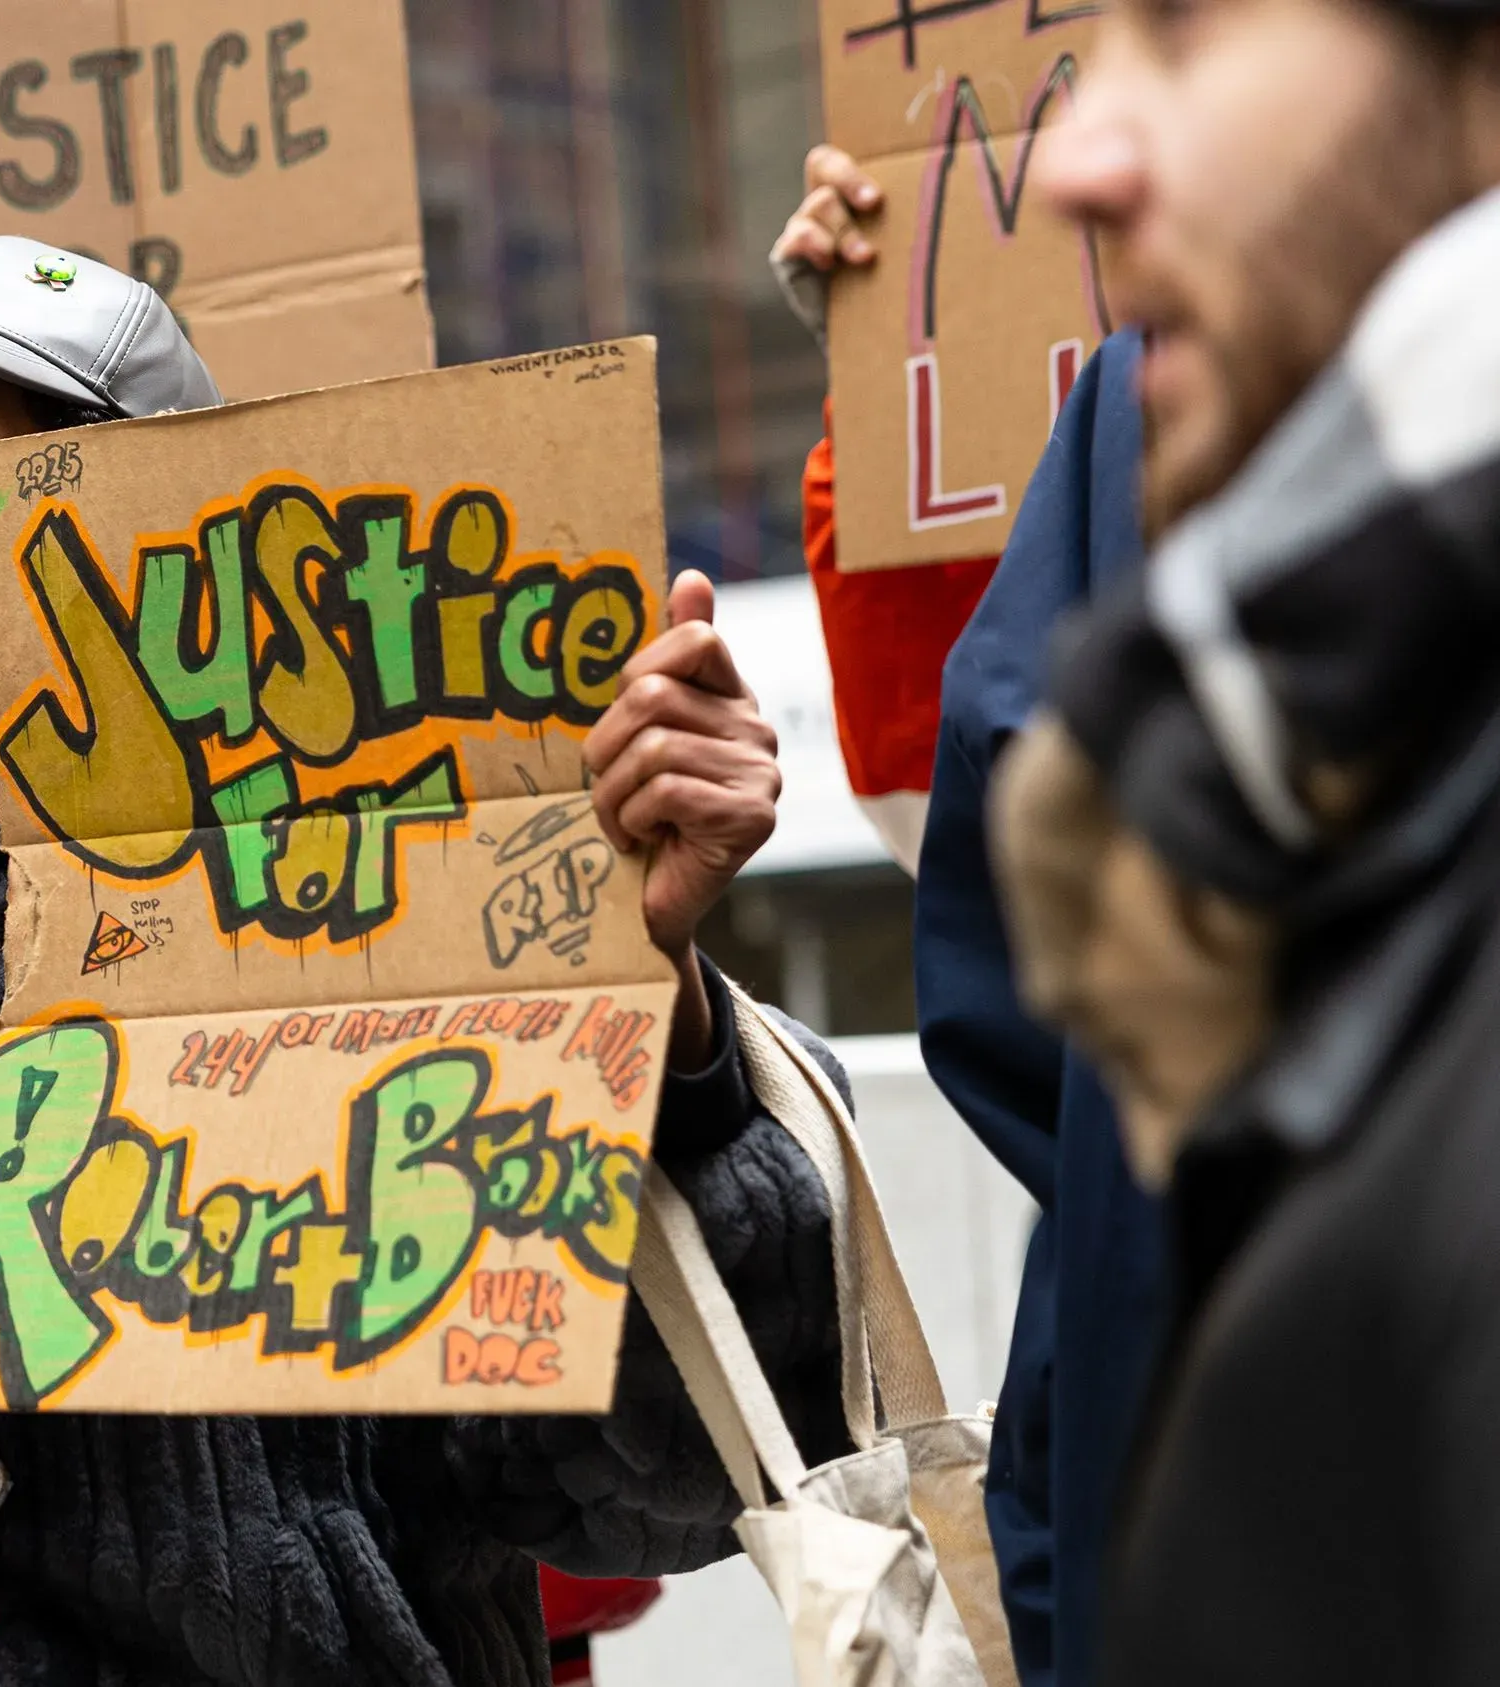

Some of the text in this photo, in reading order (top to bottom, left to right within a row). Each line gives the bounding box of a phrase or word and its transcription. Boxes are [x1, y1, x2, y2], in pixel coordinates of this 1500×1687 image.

[16, 441, 84, 500] 2025
[482, 837, 615, 969] RIP
[470, 1265, 566, 1333] FUCK
